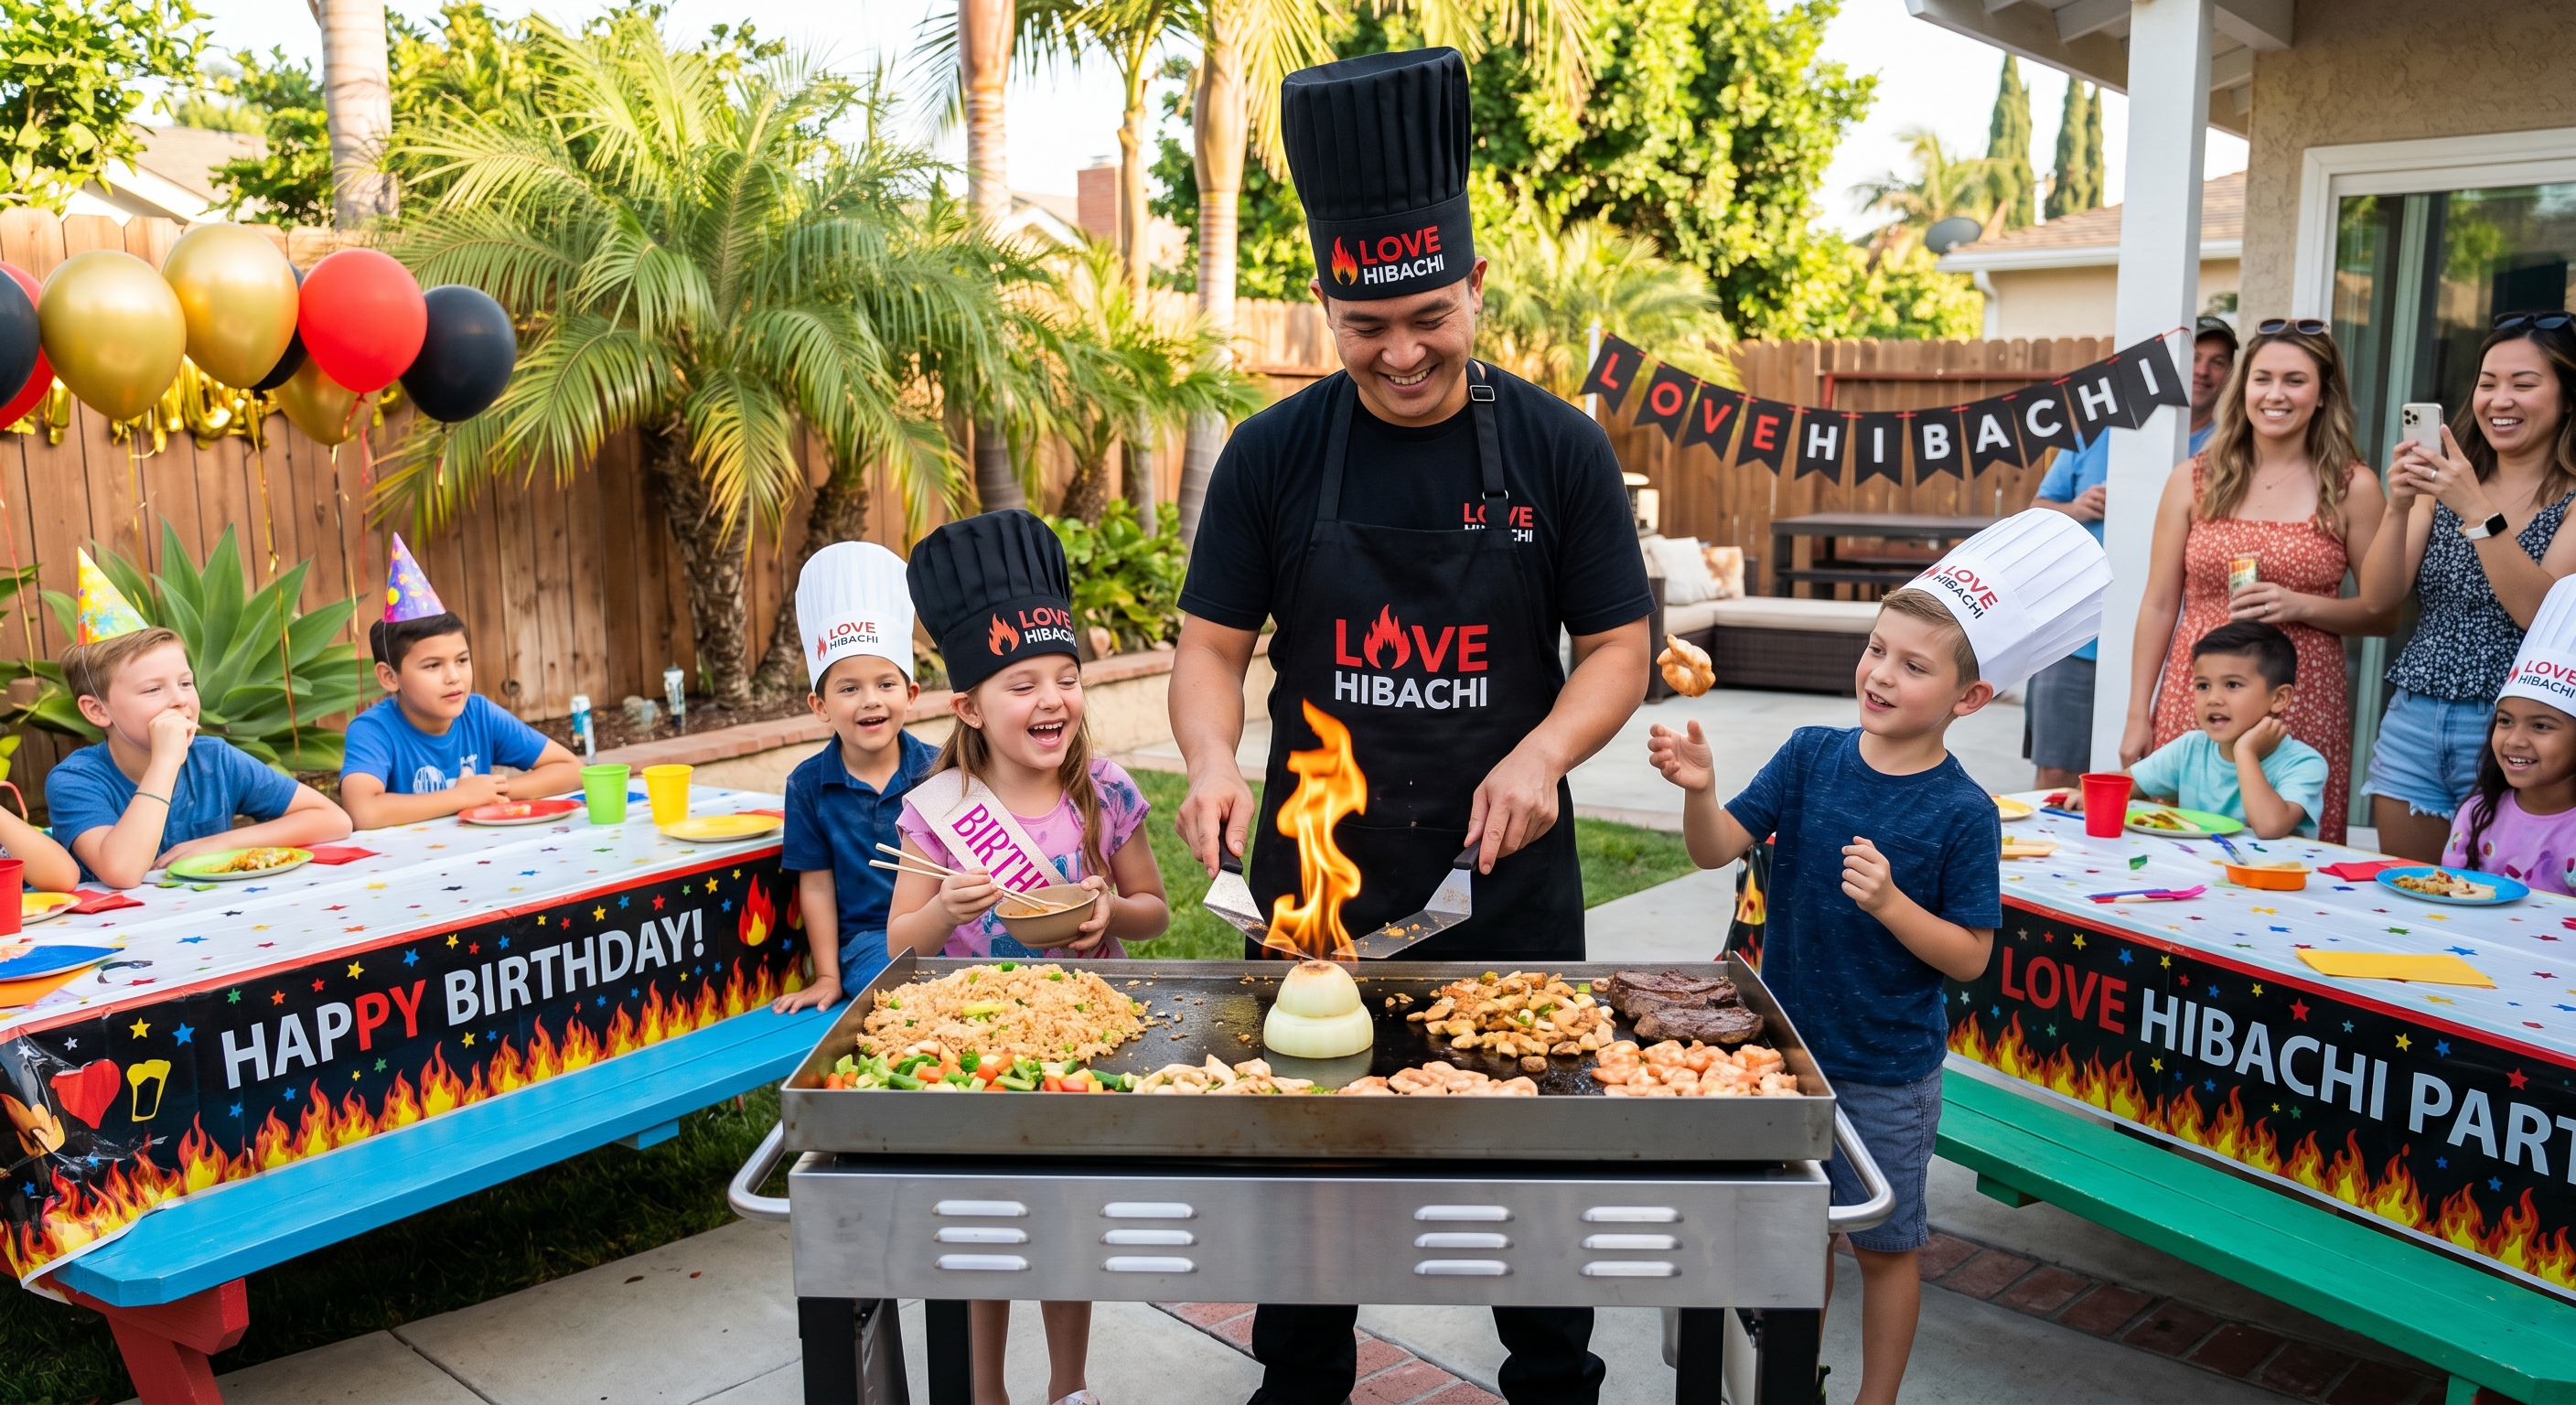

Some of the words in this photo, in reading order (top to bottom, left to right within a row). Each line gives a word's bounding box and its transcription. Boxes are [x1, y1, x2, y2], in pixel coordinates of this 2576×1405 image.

[1359, 225, 1442, 265] LOVE
[1363, 253, 1444, 285] HIBACHI
[1598, 351, 1780, 451] LOVE
[1807, 358, 2159, 463] HIBACHI
[1933, 574, 1984, 619] HIBACHI
[1943, 565, 1998, 610] LOVE
[830, 621, 876, 640] LOVE
[1018, 606, 1073, 631] LOVE
[830, 634, 878, 650] HIBACHI
[1335, 670, 1487, 710] HIBACHI
[2517, 675, 2576, 698] HIBACHI
[2524, 660, 2576, 686] LOVE
[951, 802, 1050, 894] BIRTH
[220, 980, 426, 1089] HAPPY
[445, 908, 705, 1026] BIRTHDAY!
[2001, 947, 2127, 1035] LOVE
[2141, 988, 2388, 1121] HIBACHI
